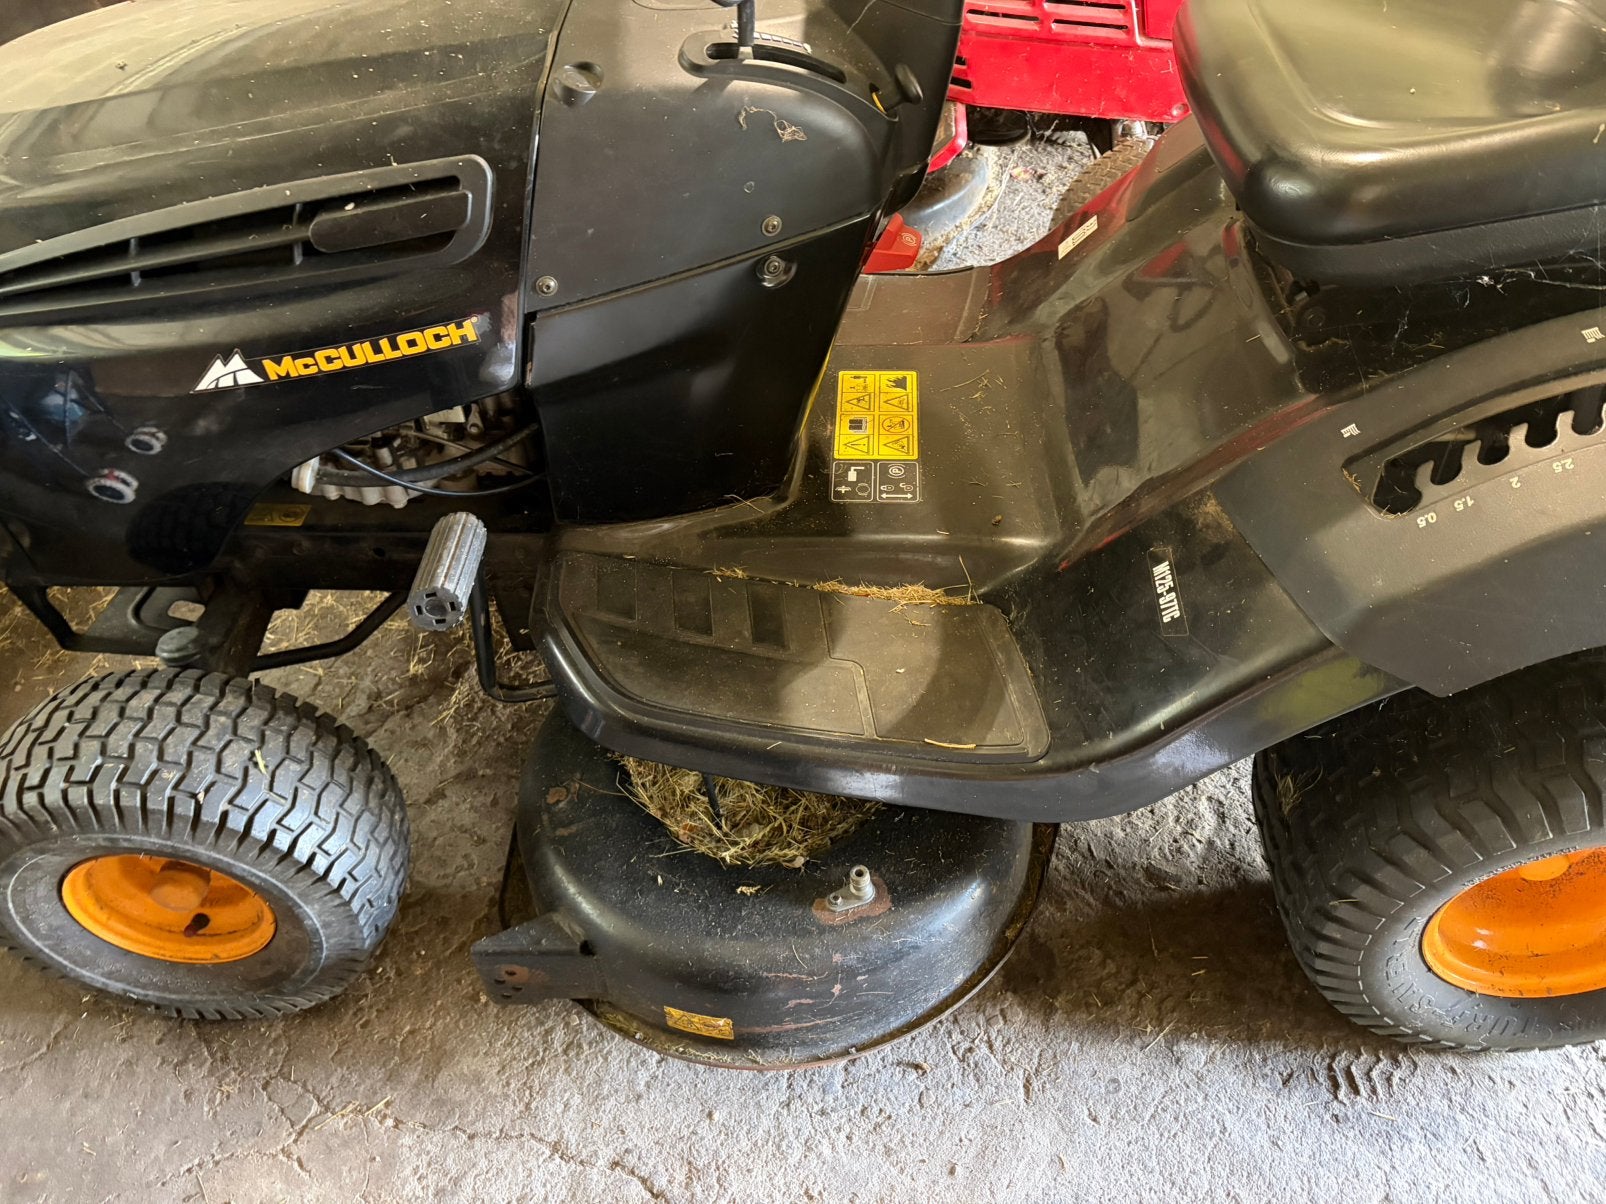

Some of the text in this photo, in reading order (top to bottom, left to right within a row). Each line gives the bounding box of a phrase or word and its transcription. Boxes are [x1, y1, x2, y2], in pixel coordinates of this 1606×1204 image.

[262, 321, 477, 381] McCULLOCH
[1552, 457, 1575, 474] 2.5
[1509, 476, 1522, 489] 2
[1453, 495, 1475, 512] 1.5
[1416, 511, 1438, 529] 0.5
[1152, 560, 1181, 623] M125-97TC
